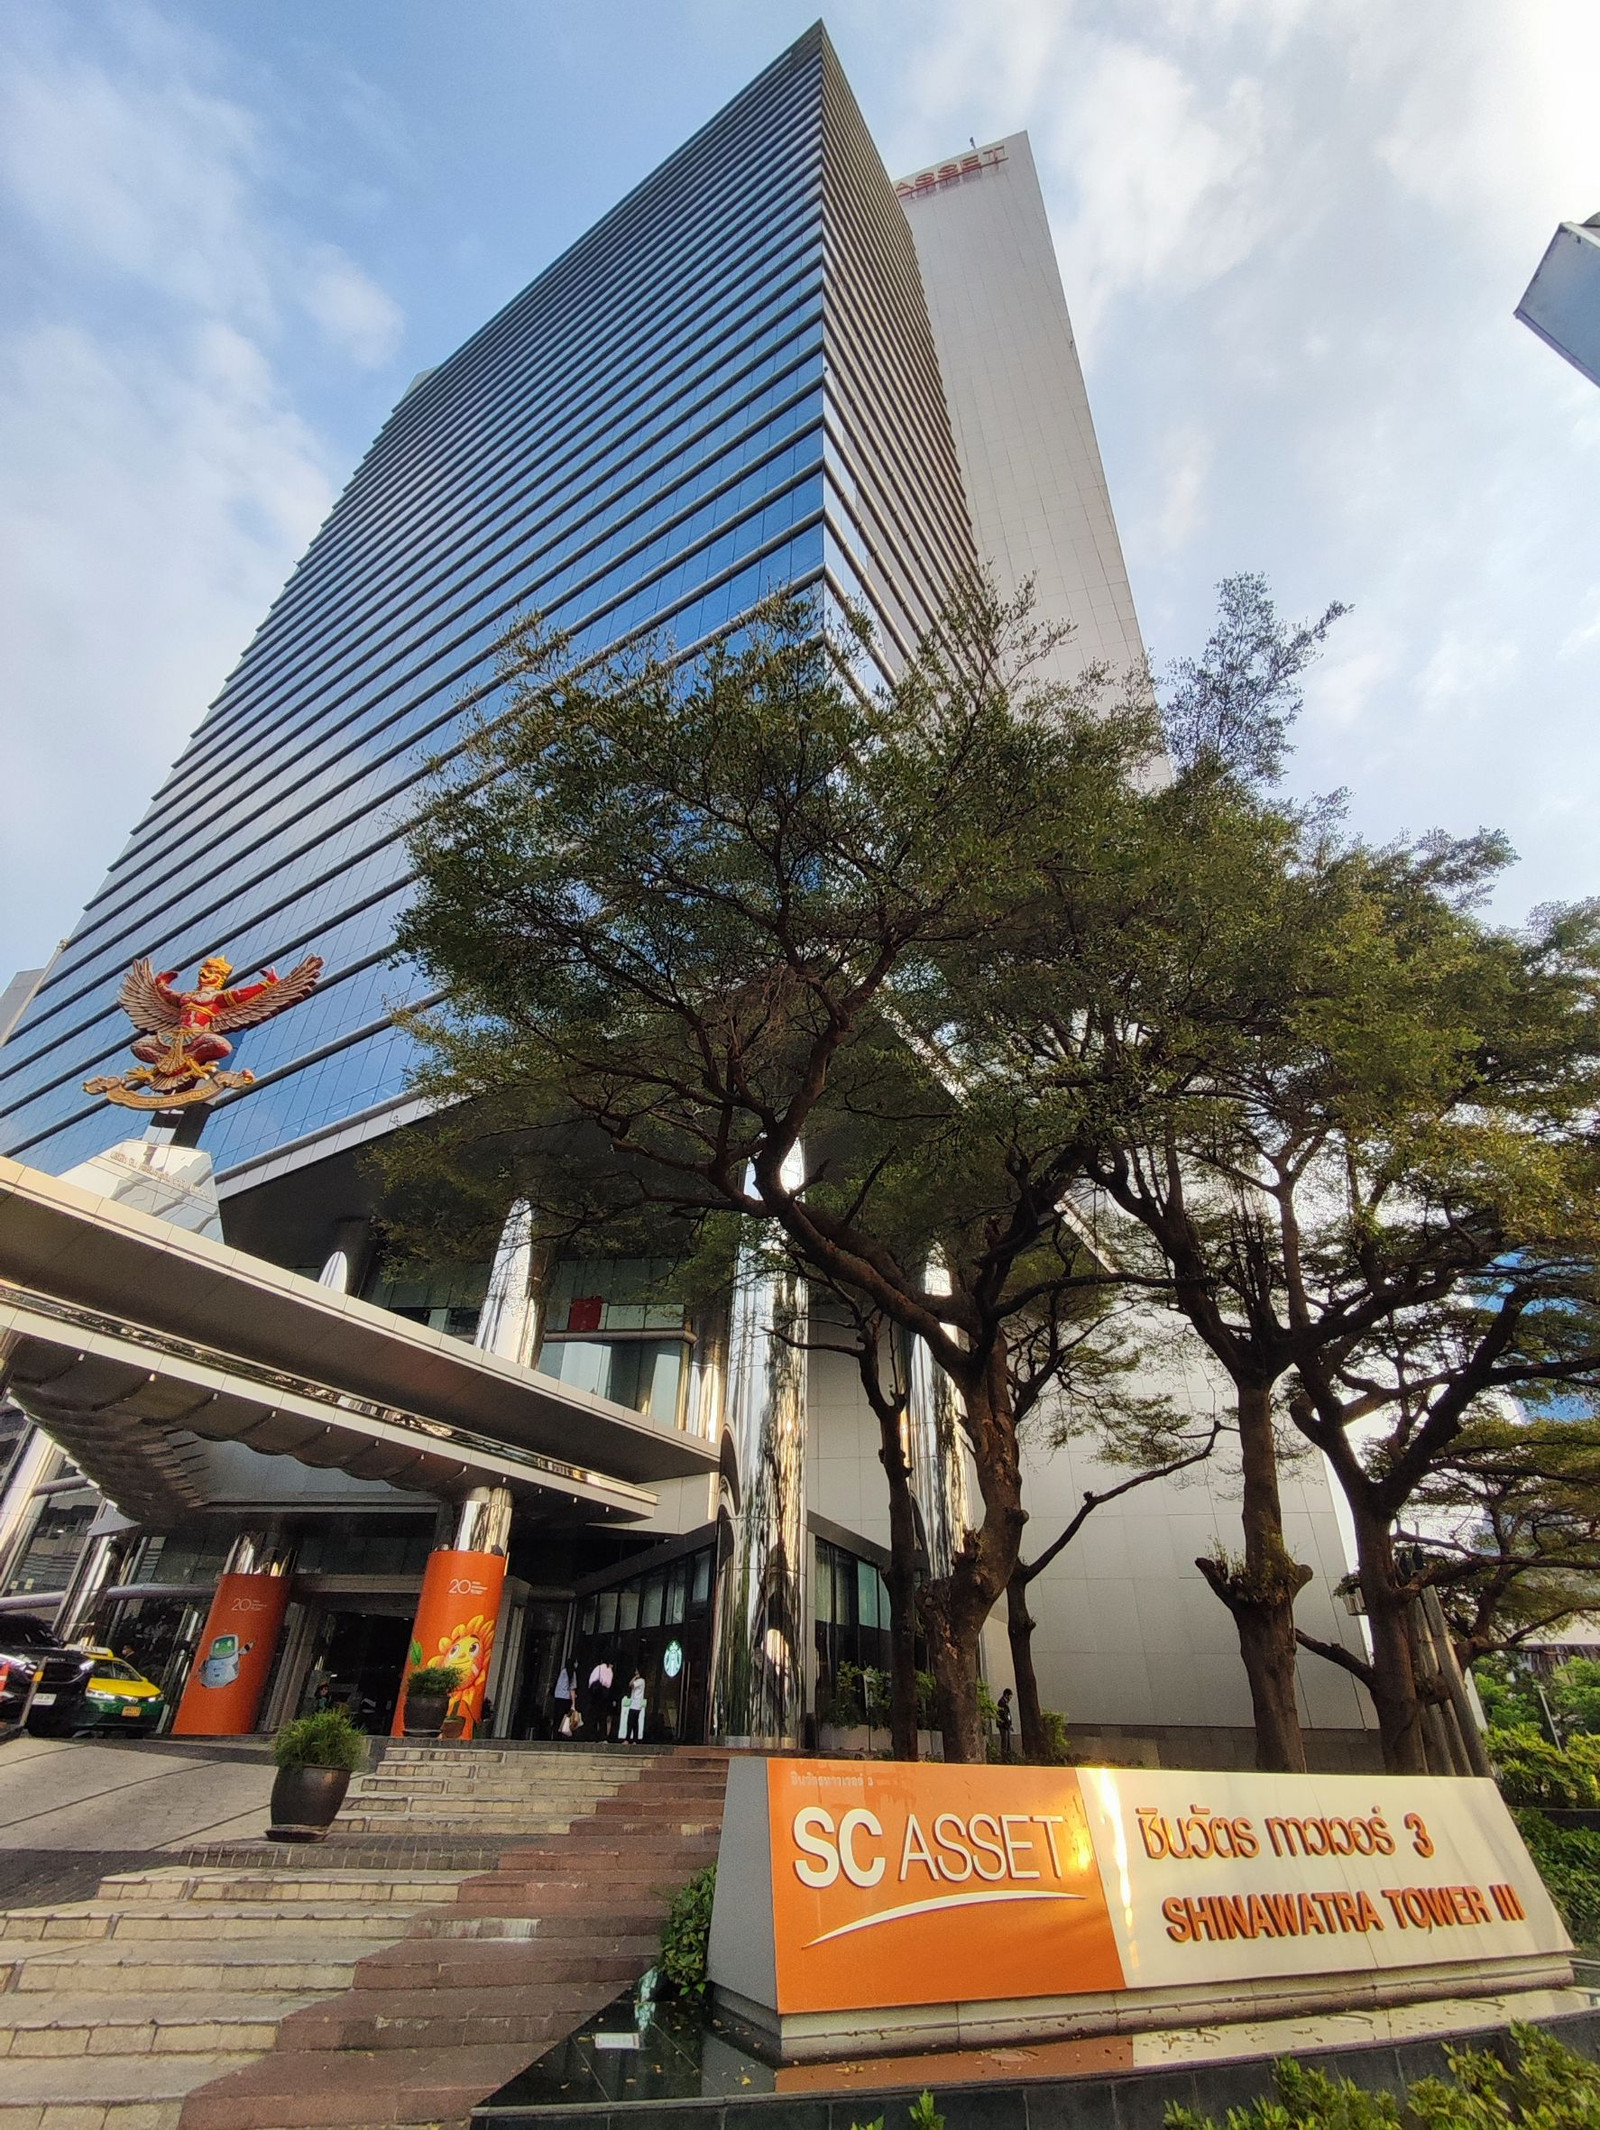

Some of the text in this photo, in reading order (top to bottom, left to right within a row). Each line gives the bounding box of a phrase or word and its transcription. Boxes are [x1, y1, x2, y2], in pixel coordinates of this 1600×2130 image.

[895, 144, 1006, 193] ASSET
[231, 1597, 252, 1611] 20
[448, 1578, 472, 1594] 20
[792, 1806, 1064, 1888] SC ASSET
[1135, 1804, 1435, 1859] ชินวัตร ทาวเวอร์ 3
[1161, 1883, 1526, 1943] SHINAWATRA TOWER III
